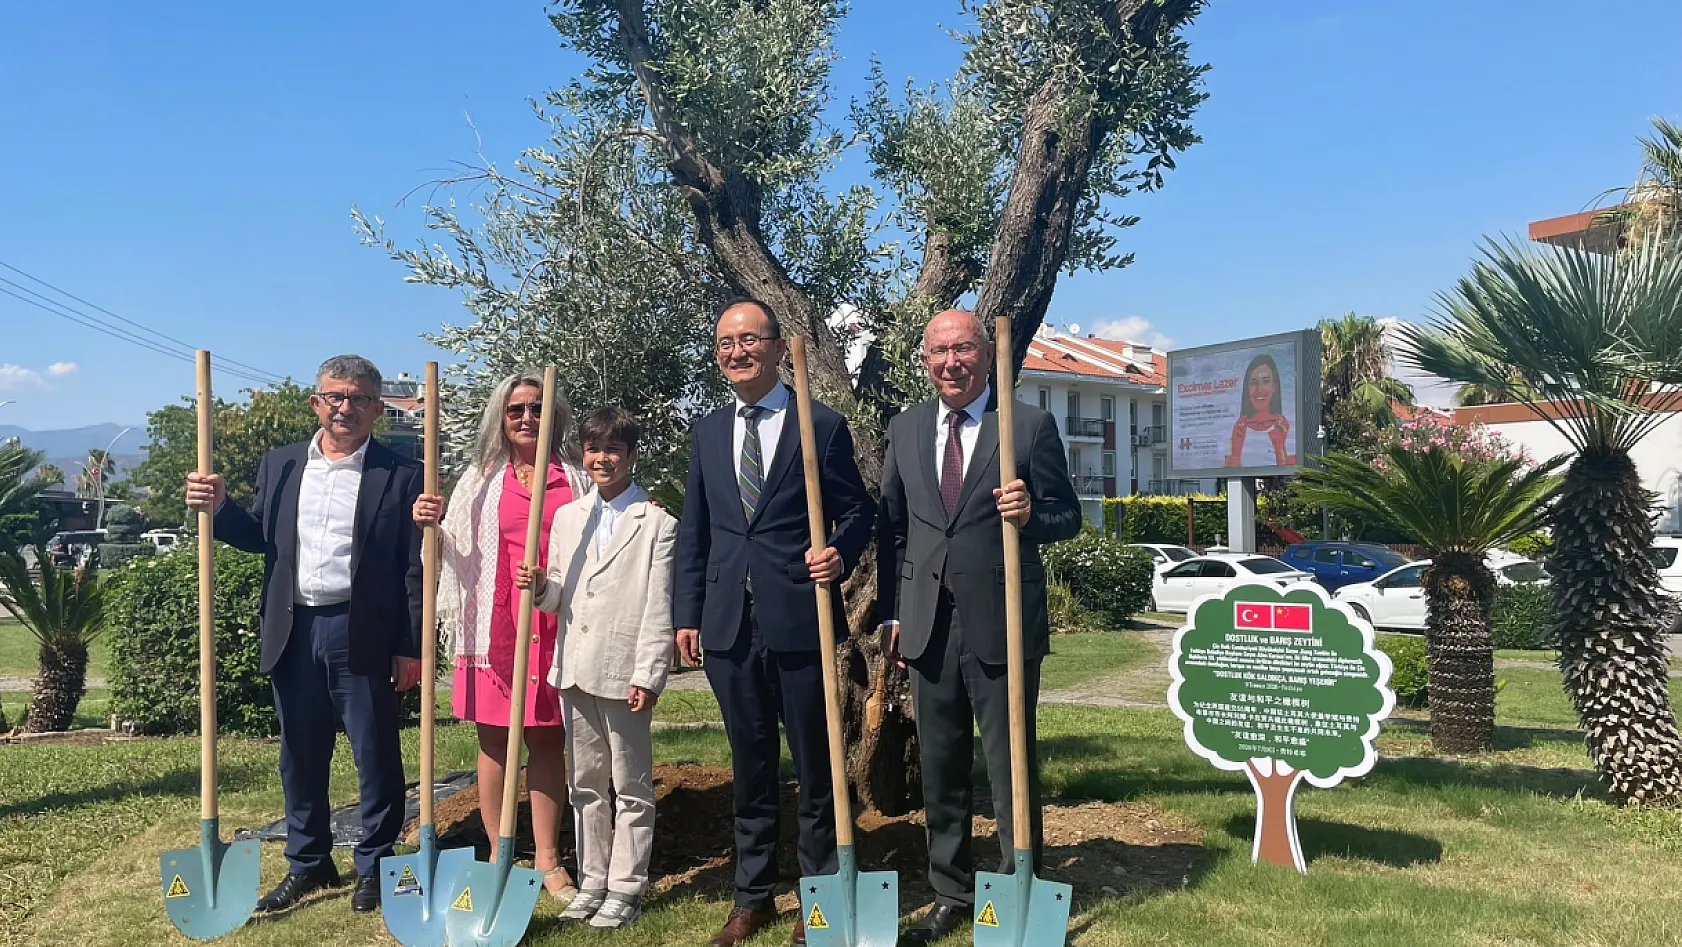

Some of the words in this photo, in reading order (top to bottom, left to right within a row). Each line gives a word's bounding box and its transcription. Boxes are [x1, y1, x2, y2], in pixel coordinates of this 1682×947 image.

[1178, 382, 1212, 393] Excimer
[1214, 378, 1238, 389] Lazer
[1225, 634, 1258, 643] DOSTLUK
[1269, 637, 1291, 646] BARIŞ
[1294, 637, 1322, 647] ZEYTİNİ
